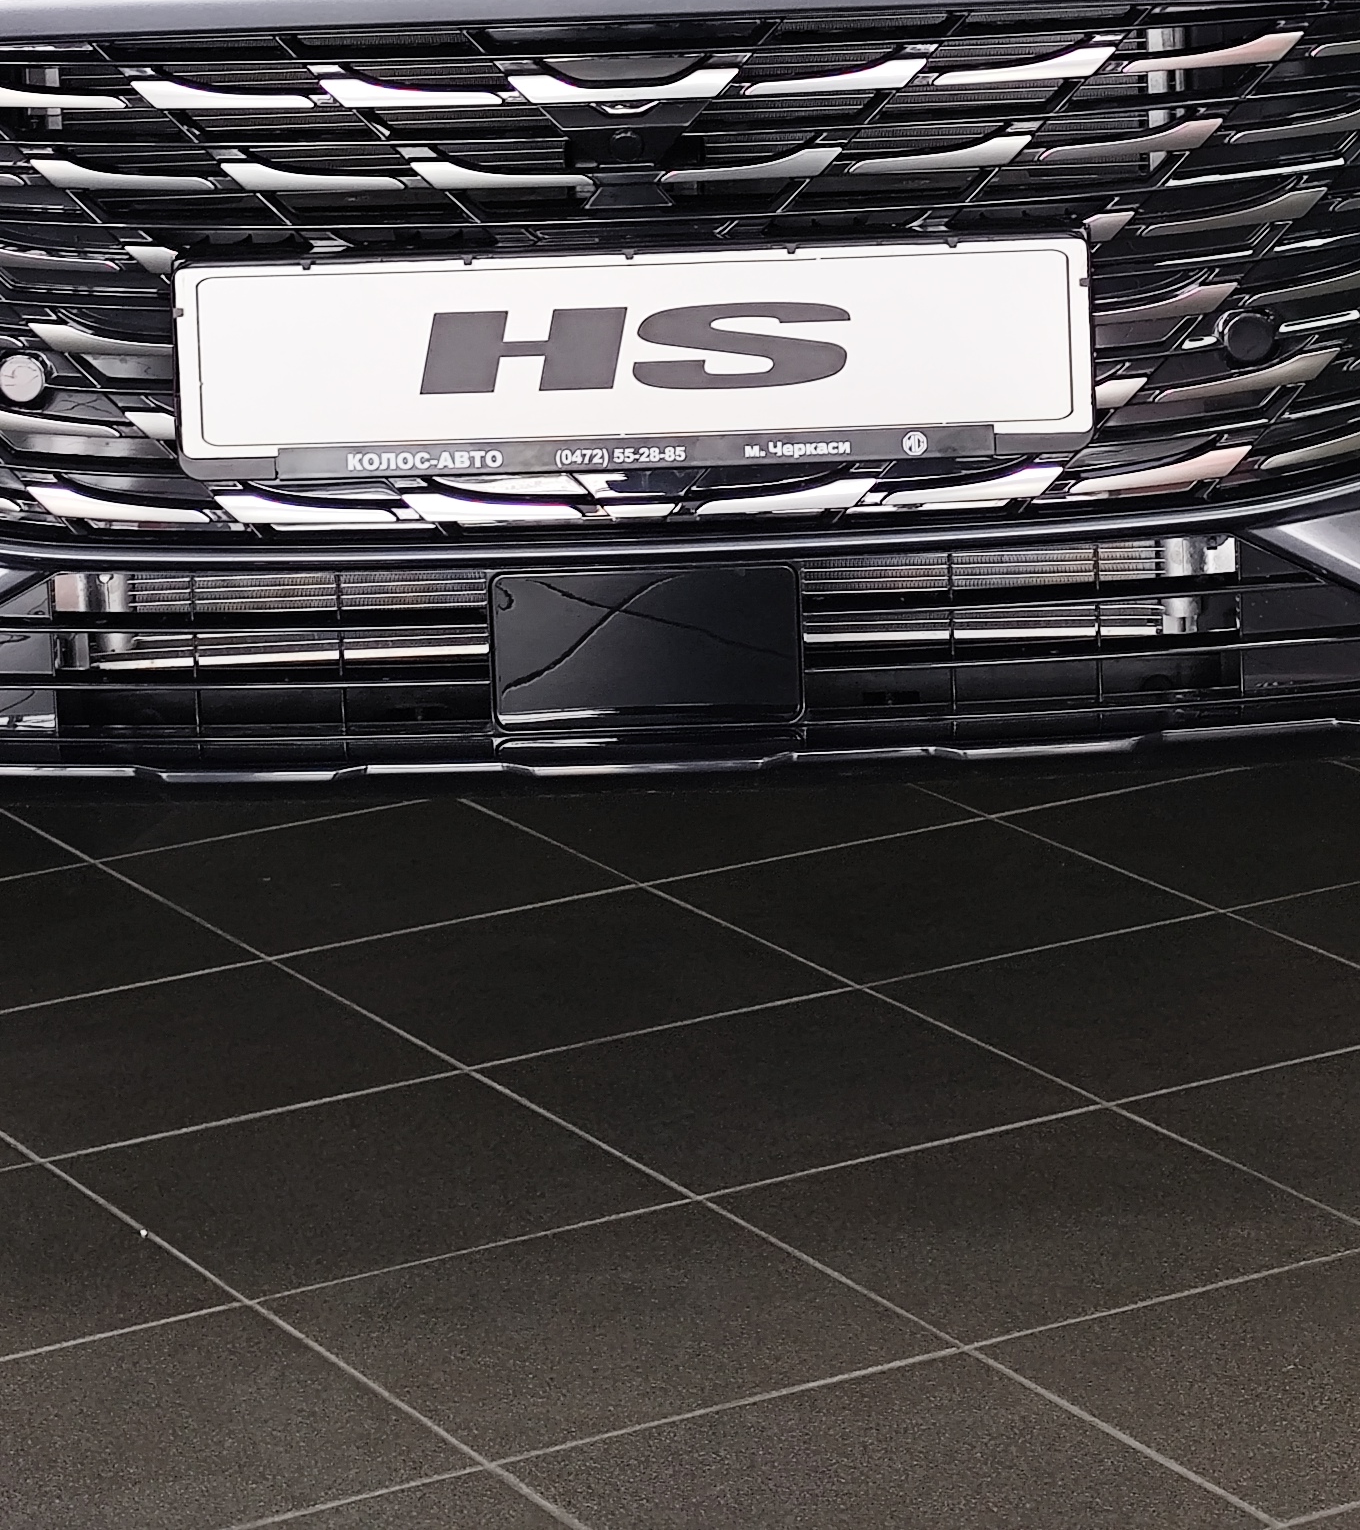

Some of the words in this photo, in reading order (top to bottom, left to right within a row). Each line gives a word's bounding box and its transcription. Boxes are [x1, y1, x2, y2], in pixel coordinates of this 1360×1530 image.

[420, 301, 851, 395] HS
[346, 450, 504, 471] КОЛОС-АВТО
[555, 448, 609, 468] (0472)
[613, 446, 686, 463] 55-28-85
[768, 440, 852, 459] Черкаси
